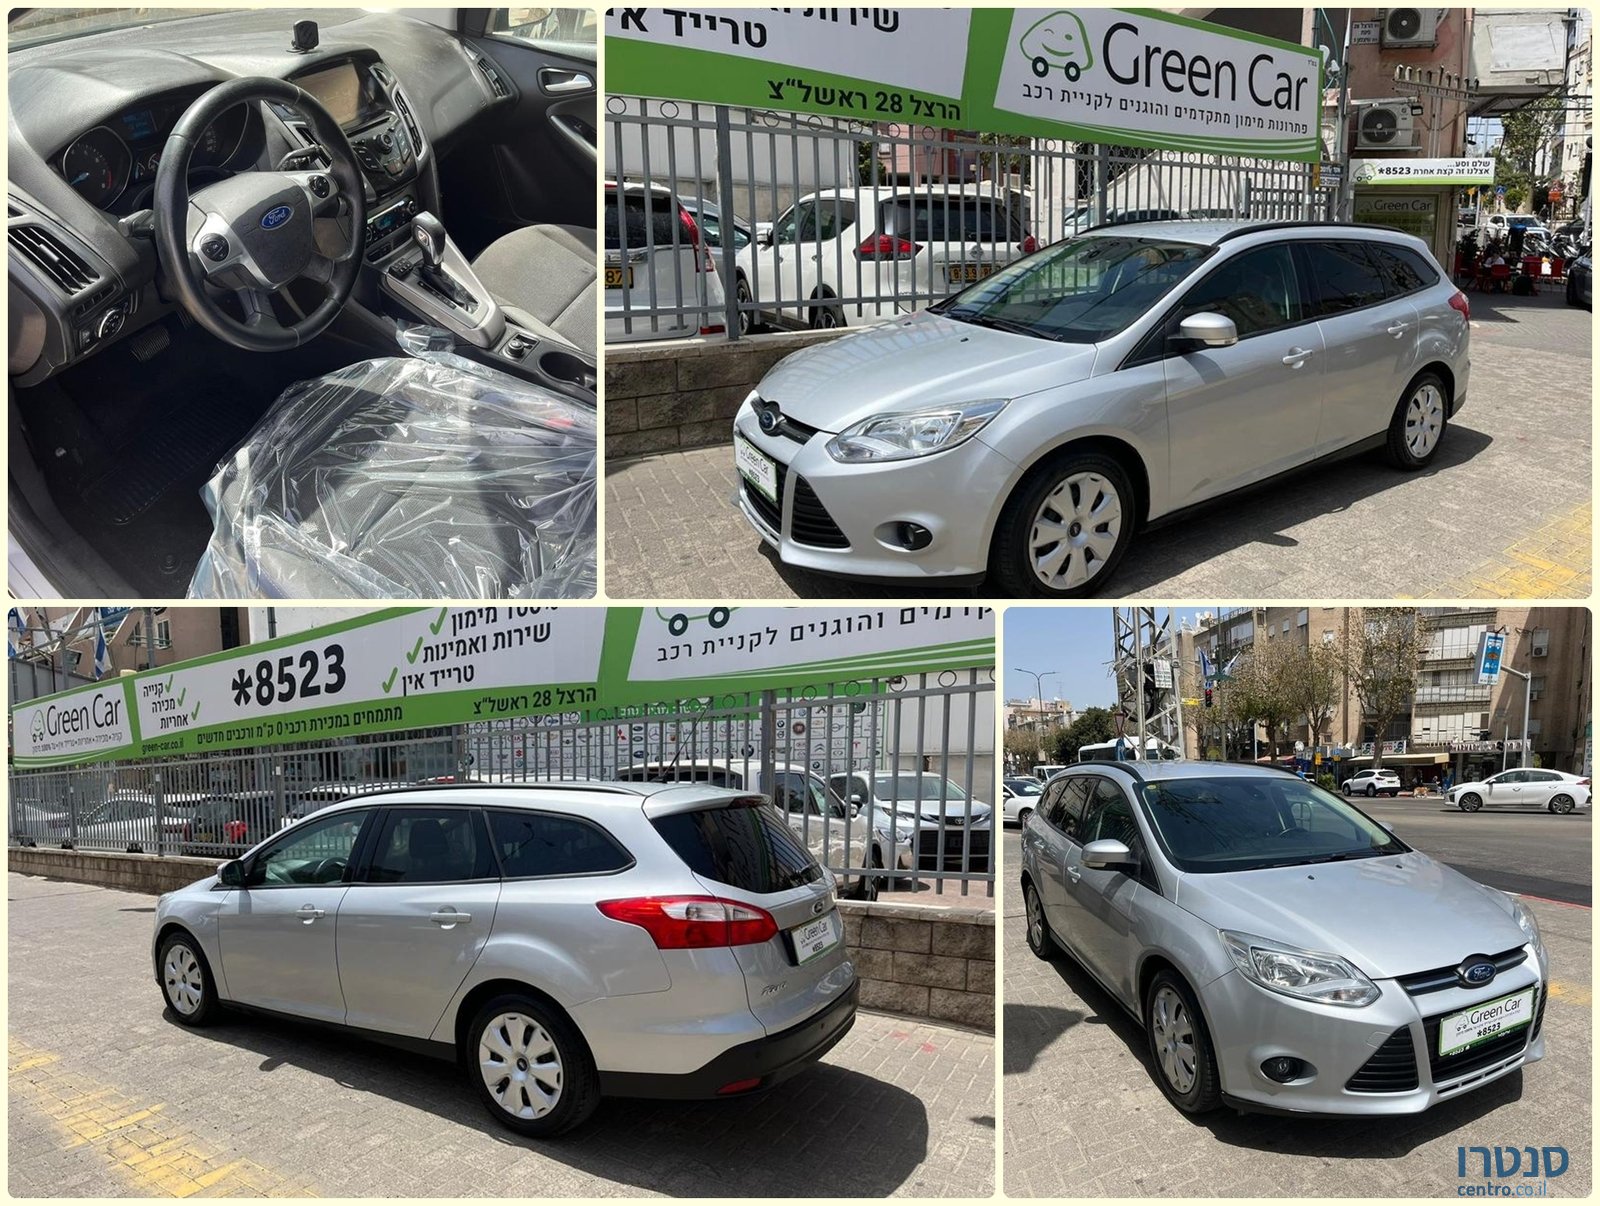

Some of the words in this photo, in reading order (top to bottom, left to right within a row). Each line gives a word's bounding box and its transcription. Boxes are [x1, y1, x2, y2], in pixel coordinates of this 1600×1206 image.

[663, 8, 767, 48] טרייד
[1103, 22, 1237, 102] Green
[1249, 54, 1308, 112] Car
[1022, 83, 1053, 101] רכב
[1060, 90, 1113, 111] לקניית
[876, 91, 903, 114] 28
[909, 94, 961, 121] הרצל
[1119, 98, 1169, 117] והוגנים
[1174, 105, 1231, 126] מתקדמים
[1235, 113, 1264, 130] מימון
[1268, 118, 1308, 135] פתרונות
[1436, 168, 1454, 176] קצת
[1374, 199, 1409, 211] Green
[1411, 199, 1432, 211] Car
[451, 607, 498, 636] מימון
[790, 611, 884, 642] והוגנים
[492, 622, 551, 650] שירות
[702, 627, 778, 655] לקניית
[423, 635, 487, 663] ואמינות
[657, 644, 693, 662] רכב
[429, 664, 475, 685] טרייד
[143, 682, 164, 698] קנייה
[402, 672, 425, 697] אין
[532, 690, 551, 707] 28
[556, 686, 597, 705] הרצל
[46, 705, 90, 736] Green
[92, 693, 121, 728] Car
[152, 698, 176, 713] מכירה
[160, 714, 189, 729] אחריות
[310, 714, 350, 732] במכירת
[353, 706, 403, 726] מתמחים
[226, 727, 254, 742] ורכבים
[276, 723, 283, 736] 0
[284, 719, 307, 735] רכבי
[142, 737, 184, 755] green-car.co.il
[197, 731, 224, 745] חדשים
[1470, 1005, 1503, 1024] Green
[1504, 999, 1522, 1012] Car
